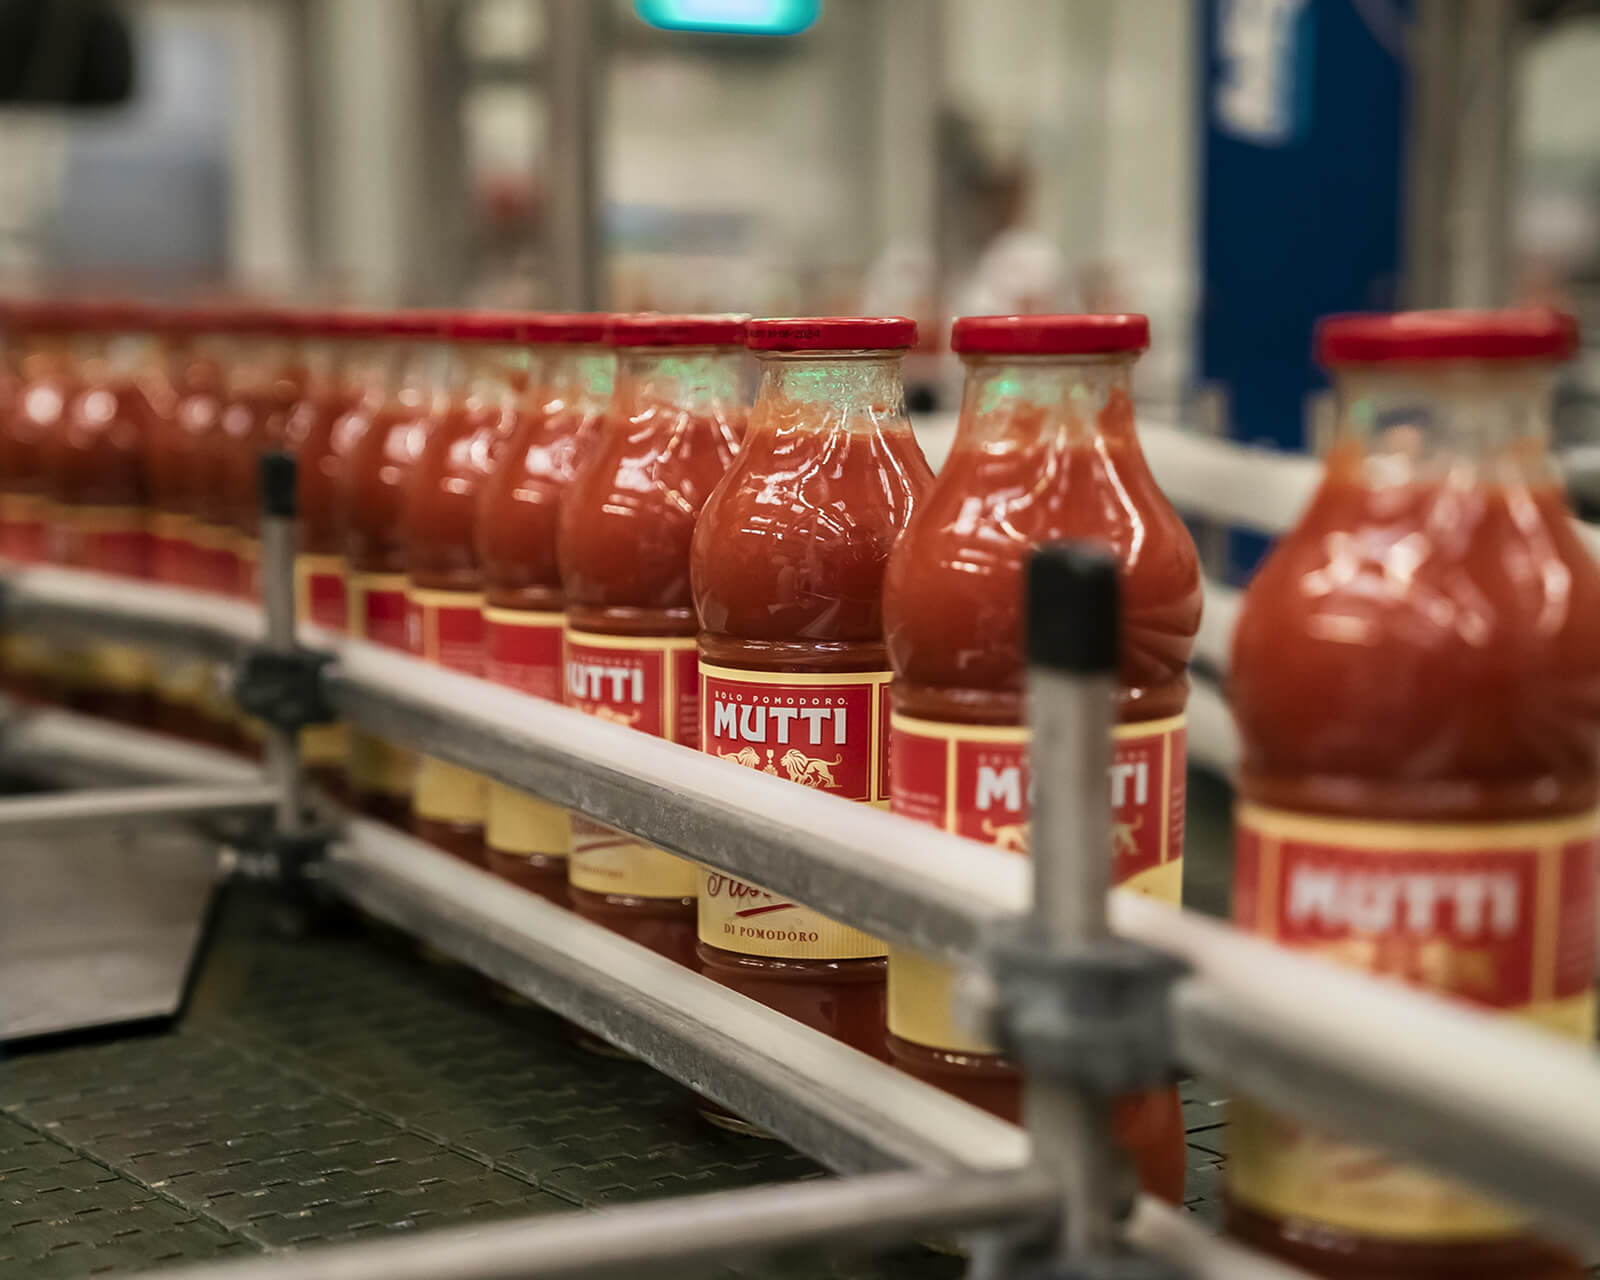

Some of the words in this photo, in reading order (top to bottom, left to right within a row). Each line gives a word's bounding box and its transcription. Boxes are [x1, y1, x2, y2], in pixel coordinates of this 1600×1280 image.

[567, 662, 643, 703] UTTI
[714, 690, 743, 702] SOLO
[713, 701, 847, 745] MUTTI
[975, 763, 1148, 812] MTI
[1288, 861, 1519, 938] MUTTI
[723, 923, 736, 936] DI
[739, 926, 819, 944] POMODORO
